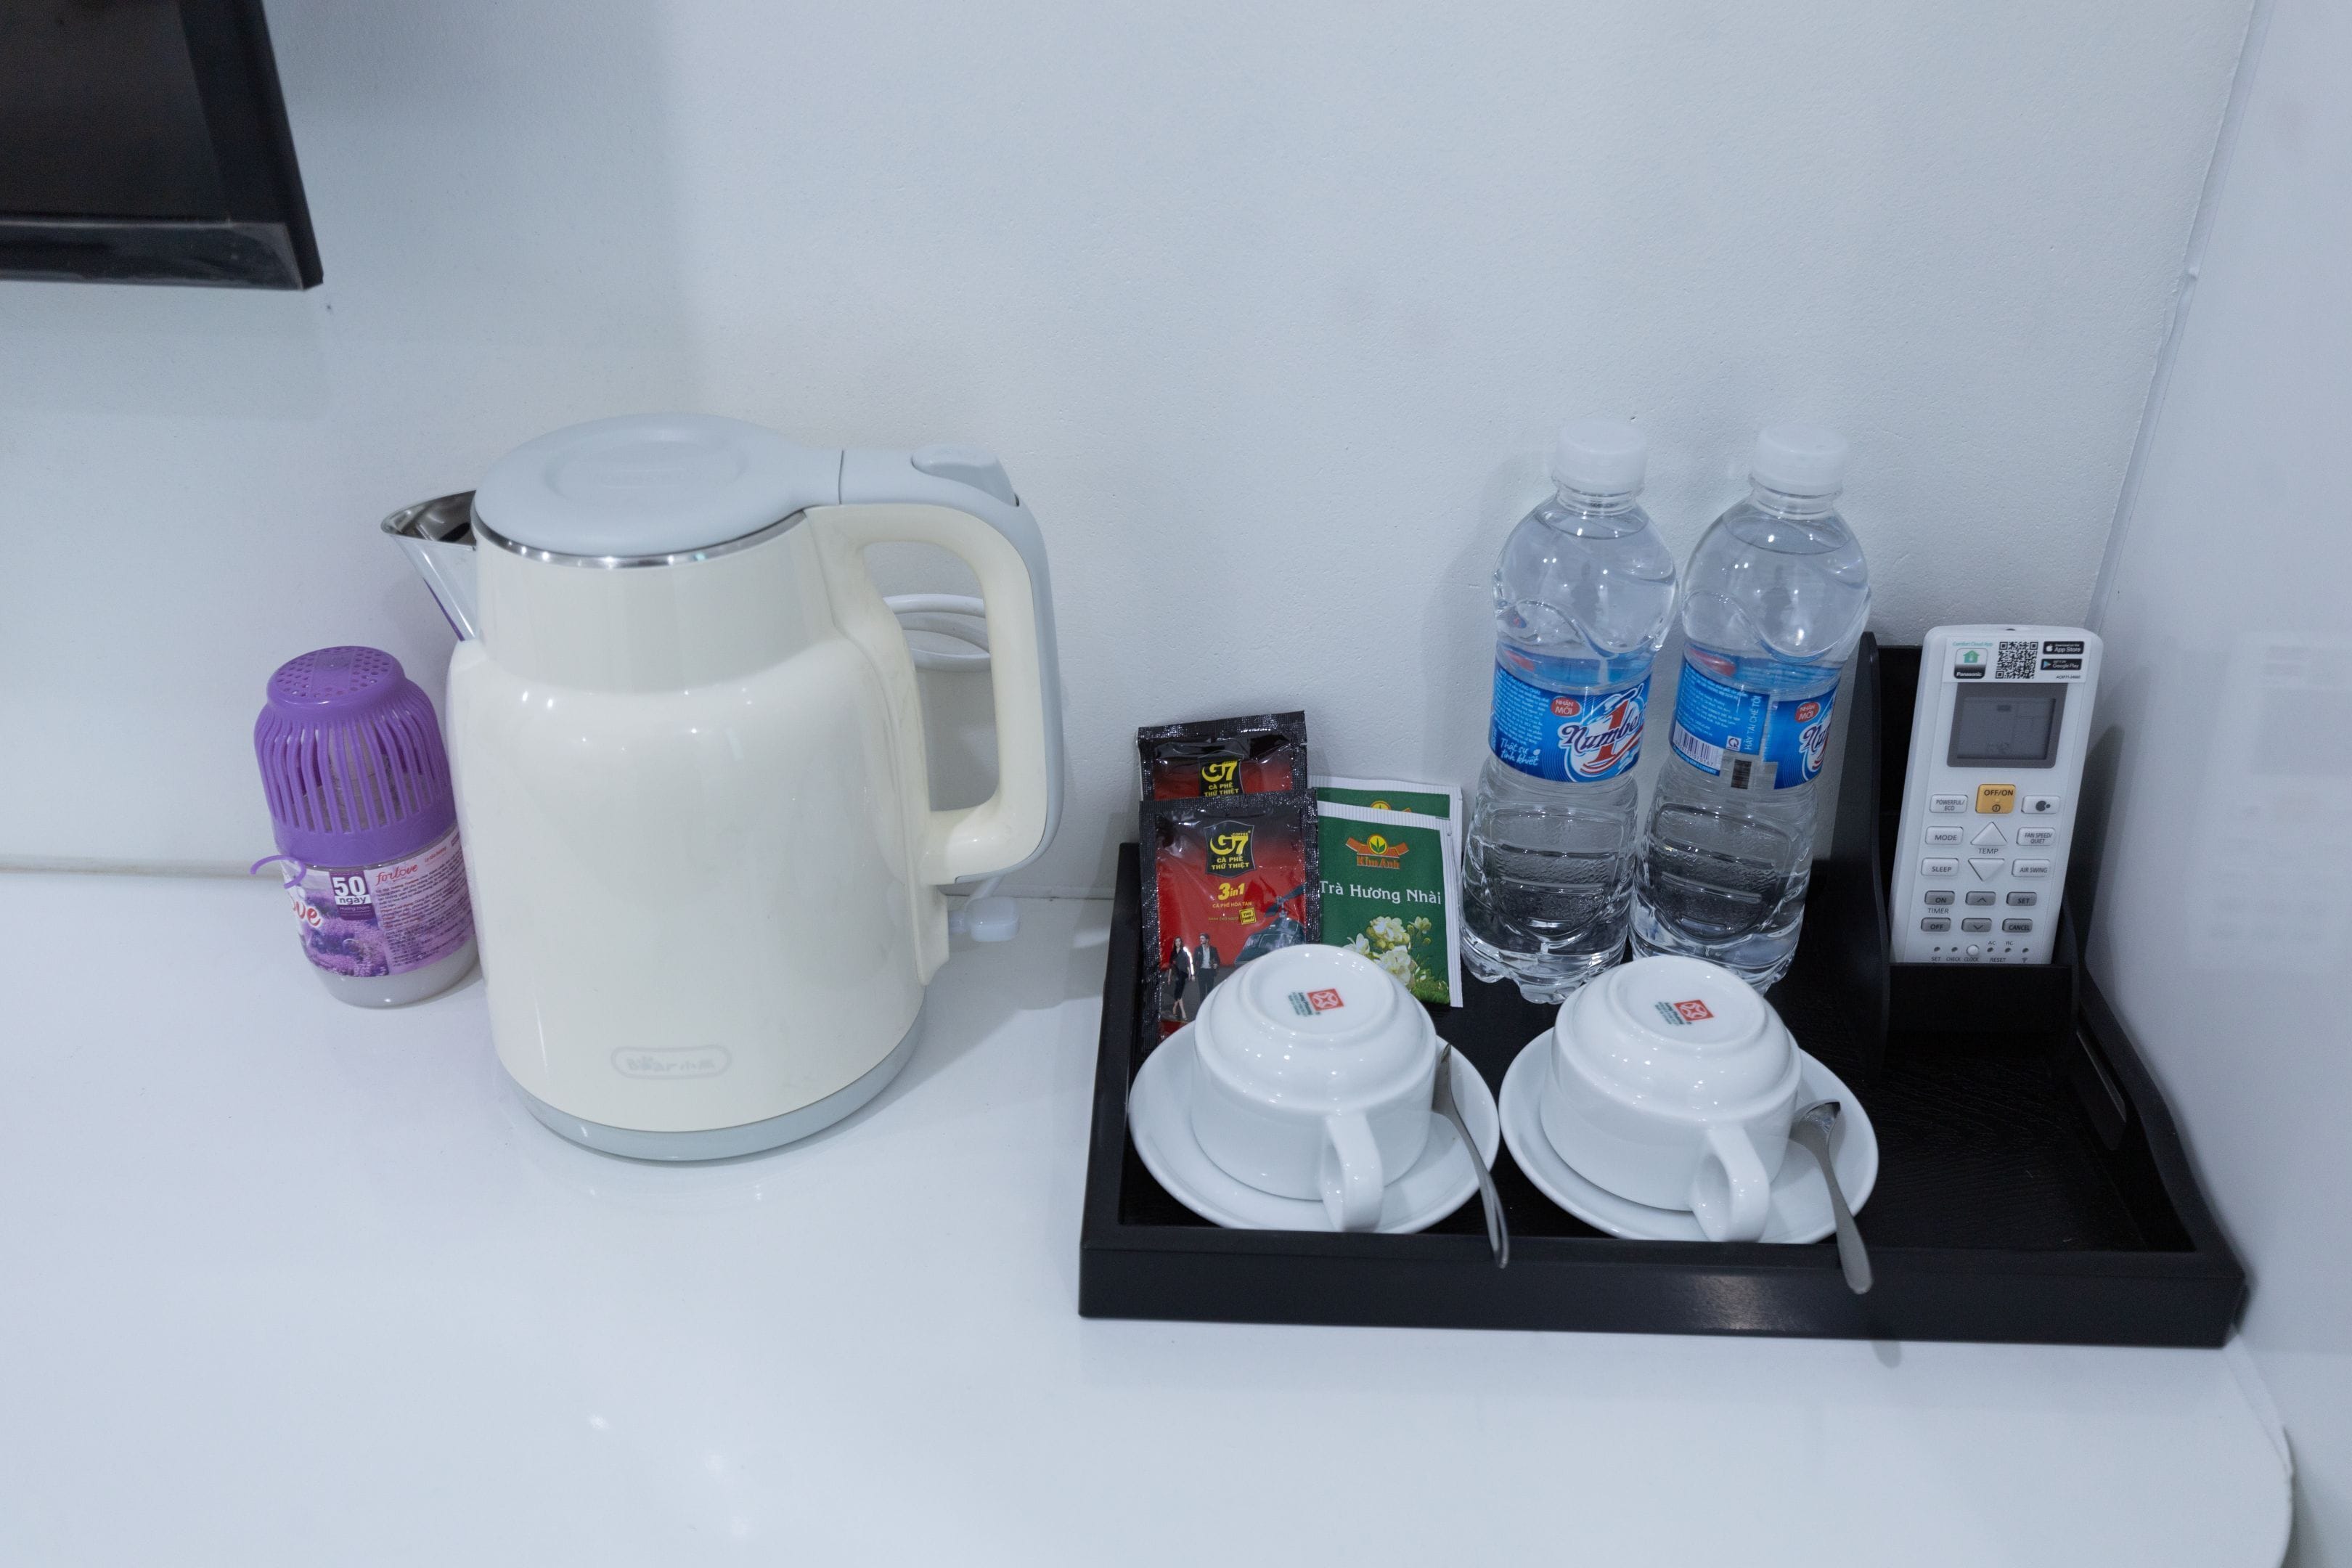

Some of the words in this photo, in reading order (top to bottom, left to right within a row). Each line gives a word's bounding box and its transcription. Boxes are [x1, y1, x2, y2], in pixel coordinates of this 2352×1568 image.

[1555, 706, 1572, 715] MỚI
[1562, 707, 1641, 754] Numbe
[1201, 761, 1238, 783] G7
[1209, 834, 1249, 855] G7
[1357, 856, 1378, 867] Kim
[1380, 857, 1400, 870] Anh
[332, 875, 366, 897] 50
[1319, 881, 1344, 895] Trà
[1349, 884, 1400, 904] Hương
[1406, 889, 1442, 905] Nhài
[339, 897, 367, 905] ngày
